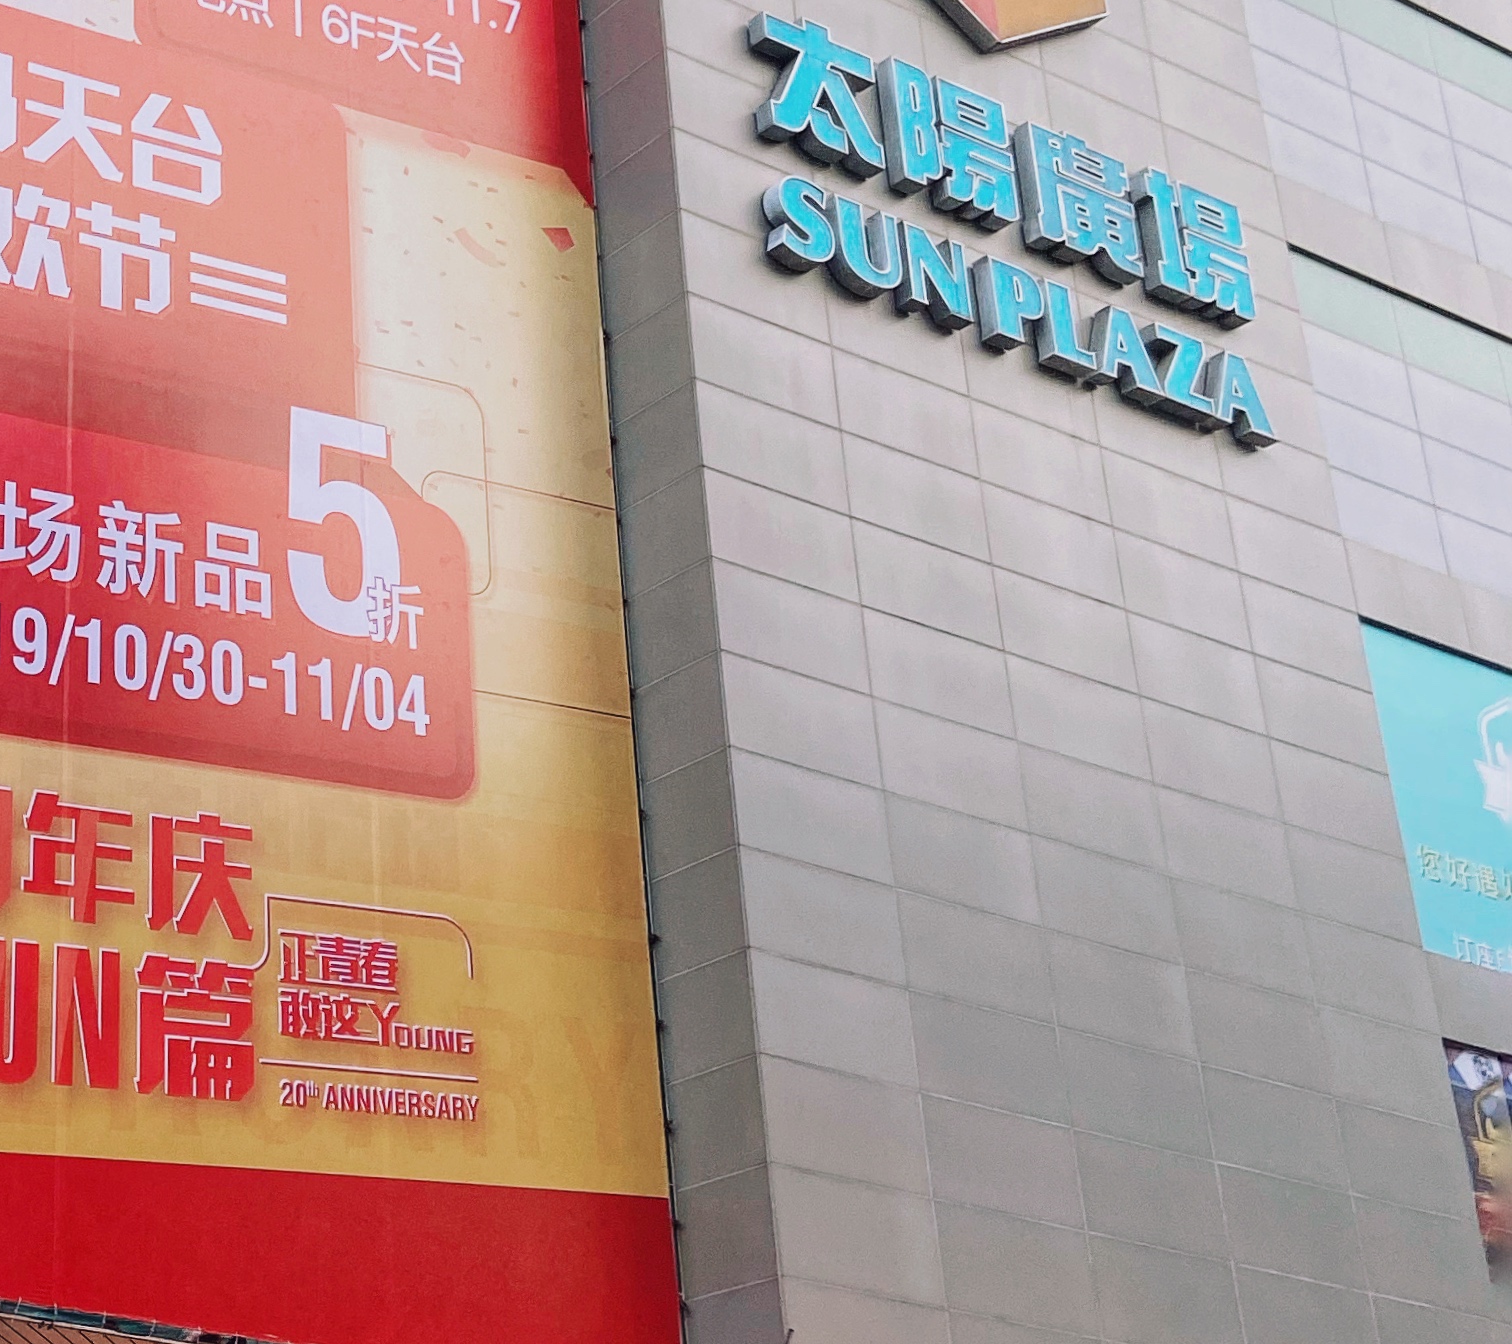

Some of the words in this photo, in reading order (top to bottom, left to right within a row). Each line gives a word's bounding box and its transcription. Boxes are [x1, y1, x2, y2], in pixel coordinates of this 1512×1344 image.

[320, 3, 467, 86] 6F天台
[761, 174, 975, 333] SUN
[972, 255, 1278, 449] PLAZA
[322, 1082, 480, 1122] ANNIVERSARY
